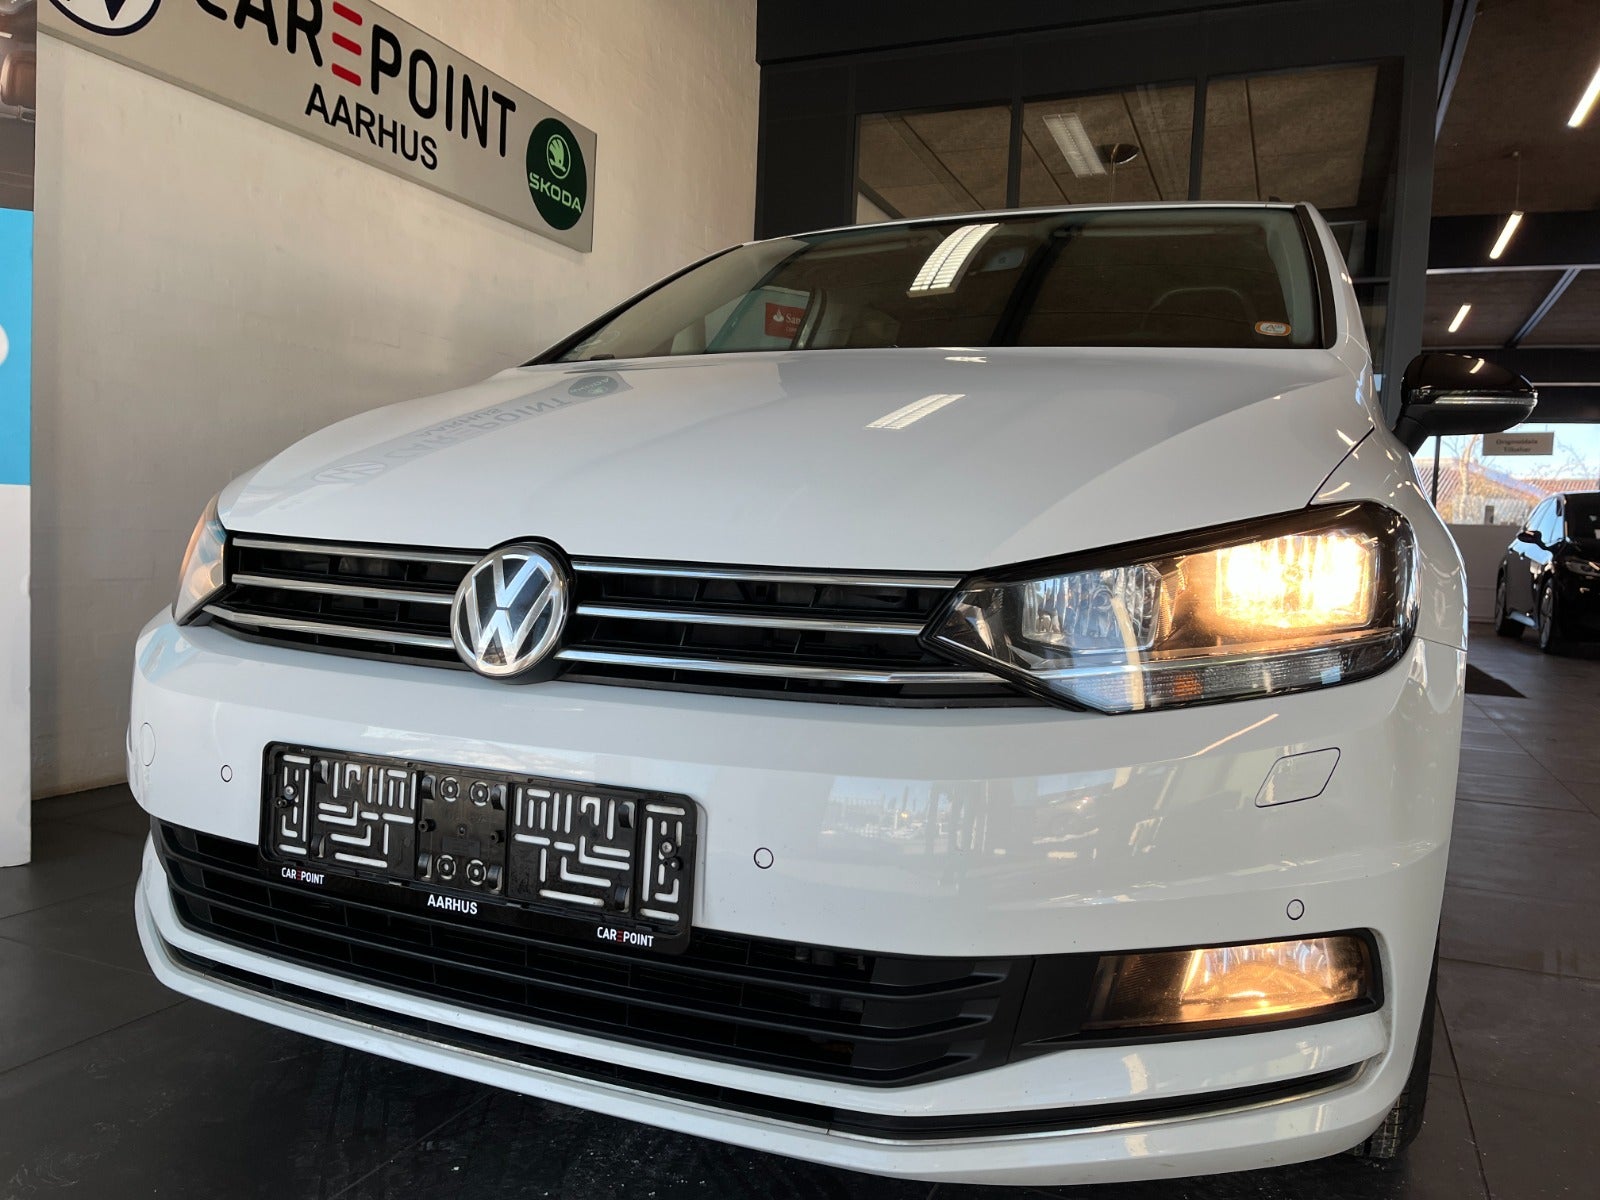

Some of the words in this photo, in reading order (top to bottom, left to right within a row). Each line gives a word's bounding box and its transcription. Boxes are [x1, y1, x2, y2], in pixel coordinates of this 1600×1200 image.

[305, 83, 438, 170] AARHUS
[529, 171, 582, 213] SKODA
[427, 894, 478, 915] AARHUS
